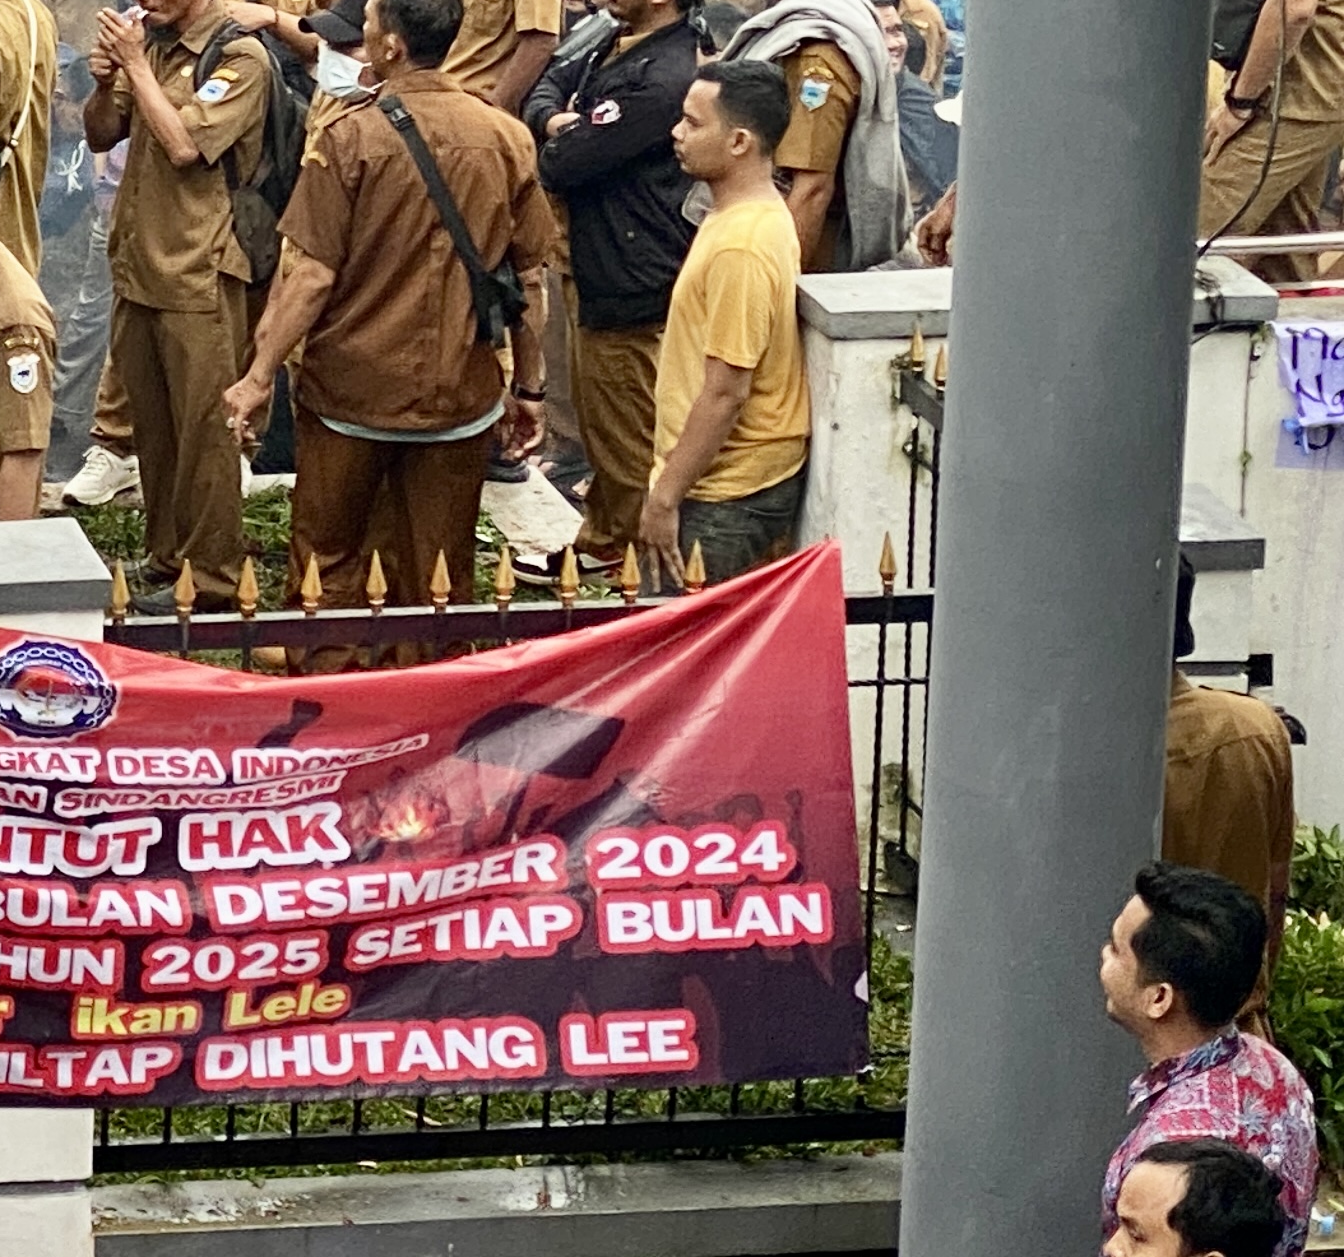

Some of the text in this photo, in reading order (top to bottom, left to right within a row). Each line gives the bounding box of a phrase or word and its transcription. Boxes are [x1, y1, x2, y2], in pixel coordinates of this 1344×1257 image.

[115, 751, 222, 781] DESA
[240, 735, 423, 780] INDONESIA
[61, 774, 338, 809] SINDANGRESMI
[188, 814, 338, 859] HAK
[213, 842, 559, 926] DESEMBER
[596, 830, 786, 880] 2024
[149, 938, 322, 986] 2025
[352, 905, 574, 966] SETIAP
[605, 892, 824, 945] BULAN
[77, 996, 197, 1035] ikan
[229, 984, 346, 1027] Lele
[204, 1027, 538, 1081] DIHUTANG
[568, 1019, 691, 1066] LEE
